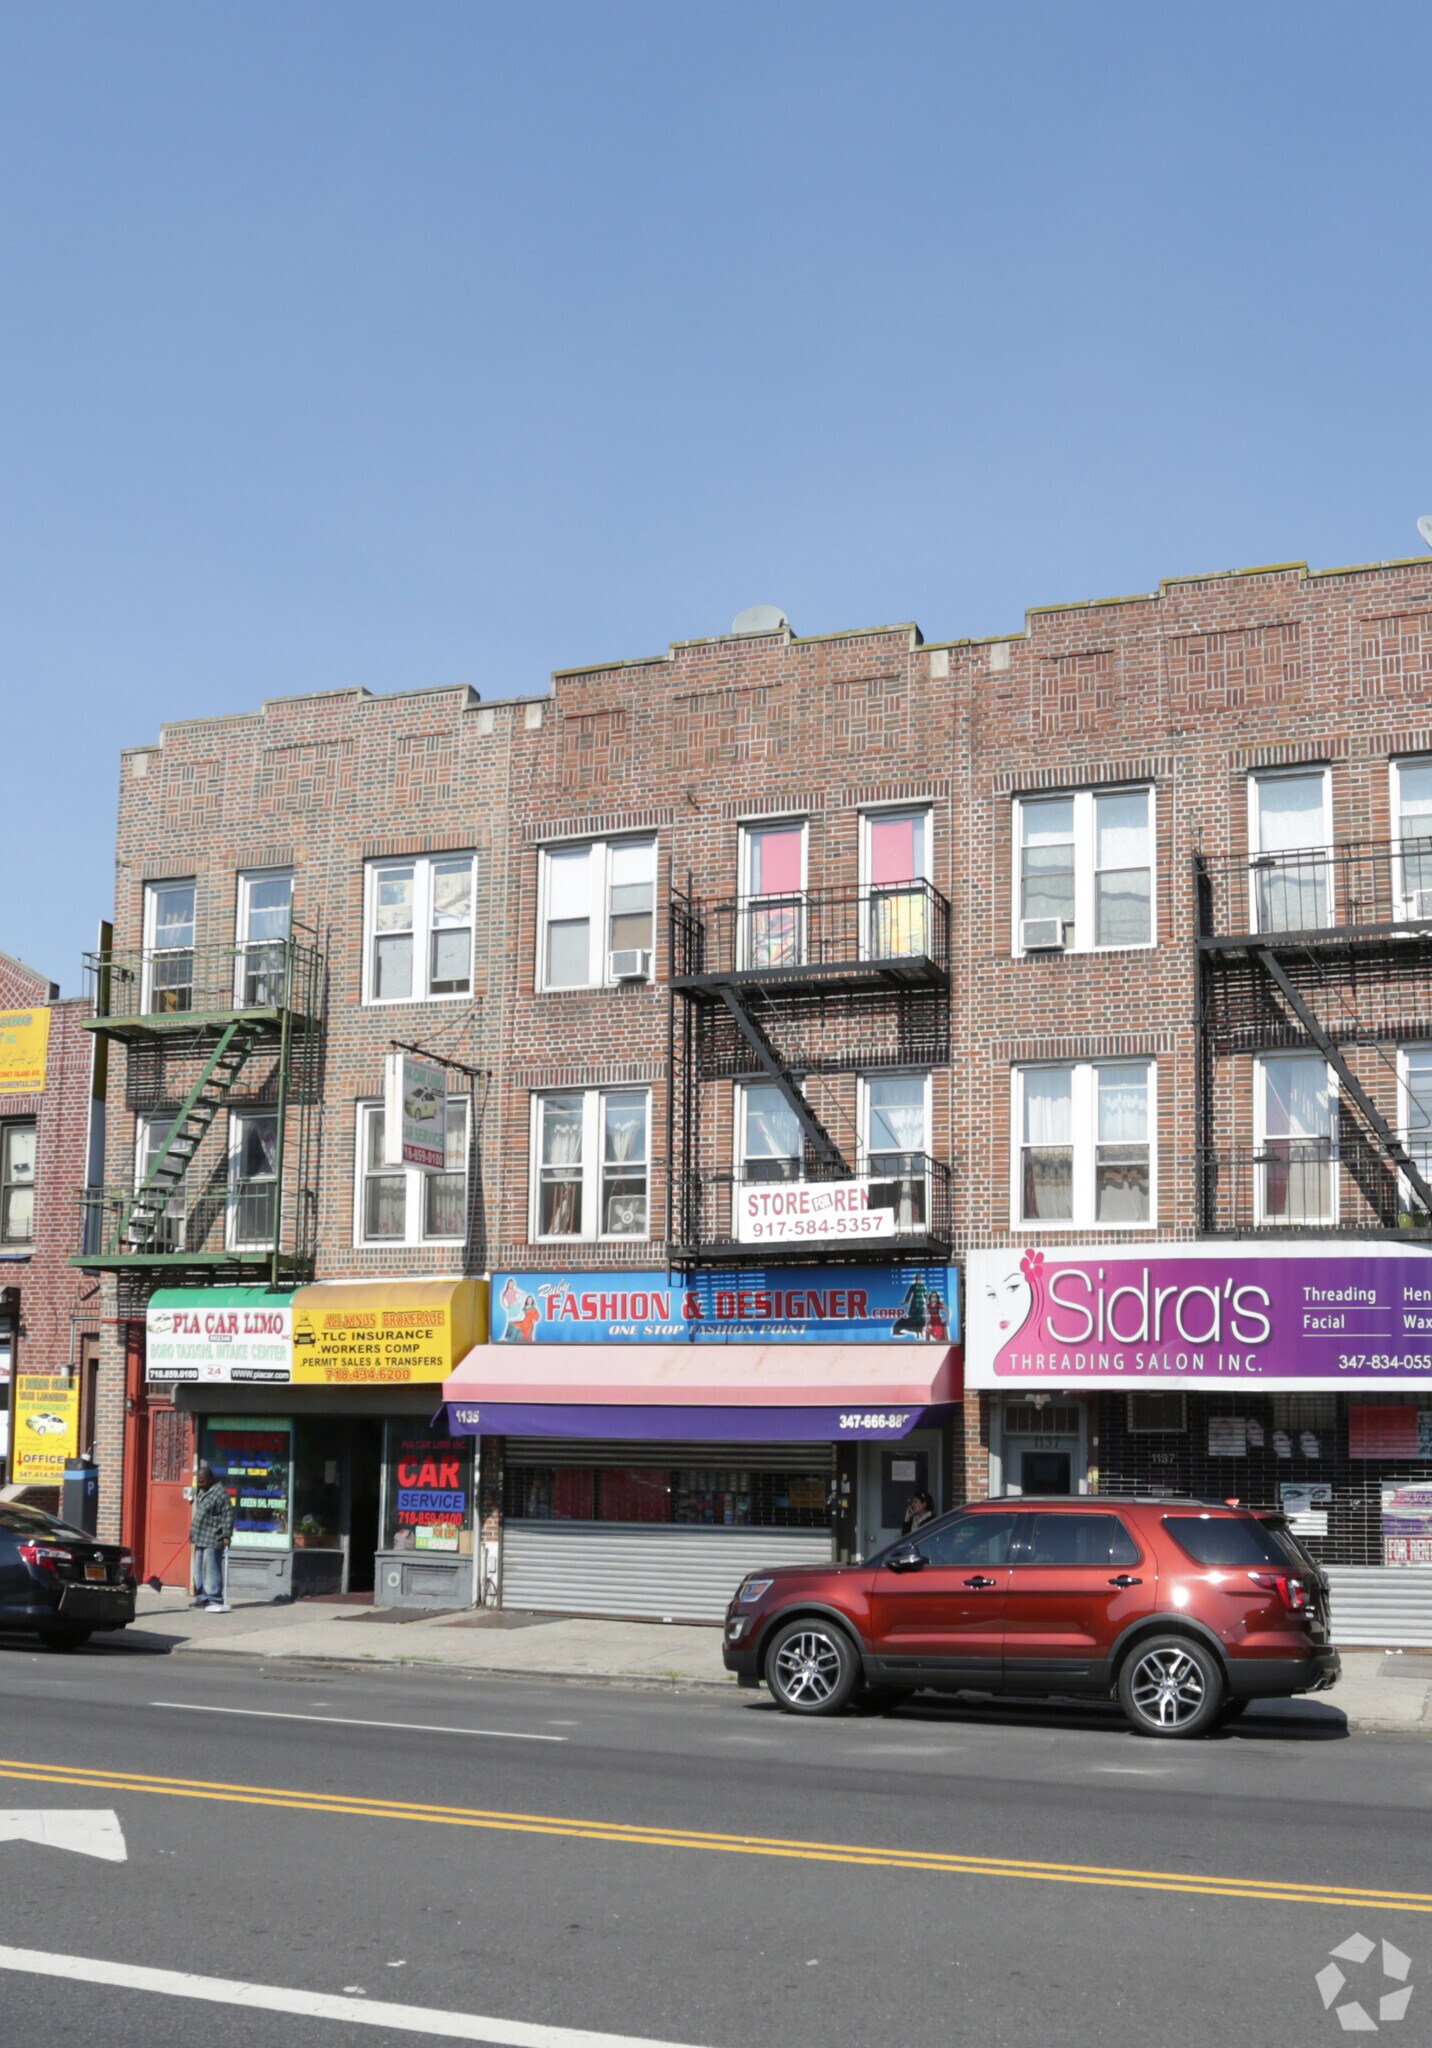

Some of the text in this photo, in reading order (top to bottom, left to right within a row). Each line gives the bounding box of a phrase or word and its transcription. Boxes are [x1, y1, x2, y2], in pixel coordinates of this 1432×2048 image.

[404, 1146, 443, 1167] 18-859-0100
[748, 1191, 810, 1217] STORE
[813, 1194, 832, 1212] FOR
[753, 1216, 883, 1238] 917-584-5357
[538, 1278, 571, 1299] Ruby
[1303, 1286, 1432, 1304] Threading Hen
[545, 1291, 671, 1321] FASHION
[682, 1291, 705, 1321] &
[715, 1289, 868, 1320] DESIGNER
[1046, 1267, 1271, 1344] Sidra's
[172, 1312, 200, 1334] PIA
[205, 1312, 239, 1335] CAR
[244, 1312, 284, 1335] LIMO
[344, 1313, 376, 1329] KINGS
[382, 1310, 445, 1327] BROKERAGE
[1303, 1314, 1345, 1329] Facial
[351, 1330, 434, 1340] INSURANCE
[608, 1323, 808, 1336] ONE STOP FASHION POINT
[251, 1345, 287, 1361] CENTER
[385, 1344, 420, 1353] COMP
[341, 1357, 372, 1366] SALES
[375, 1357, 382, 1366] &
[385, 1356, 443, 1366] TRANSFERS
[1010, 1353, 1263, 1371] THREADING SALON INC.
[207, 1367, 222, 1376] 24
[325, 1367, 411, 1381] 718.434.6200
[456, 1410, 479, 1423] 1135
[1034, 1436, 1060, 1449] 1137
[23, 1454, 64, 1464] OFFICE
[1151, 1453, 1176, 1463] 1137
[398, 1454, 460, 1488] CAR
[400, 1493, 462, 1509] SERVICE
[399, 1511, 462, 1527] 718-859-0100
